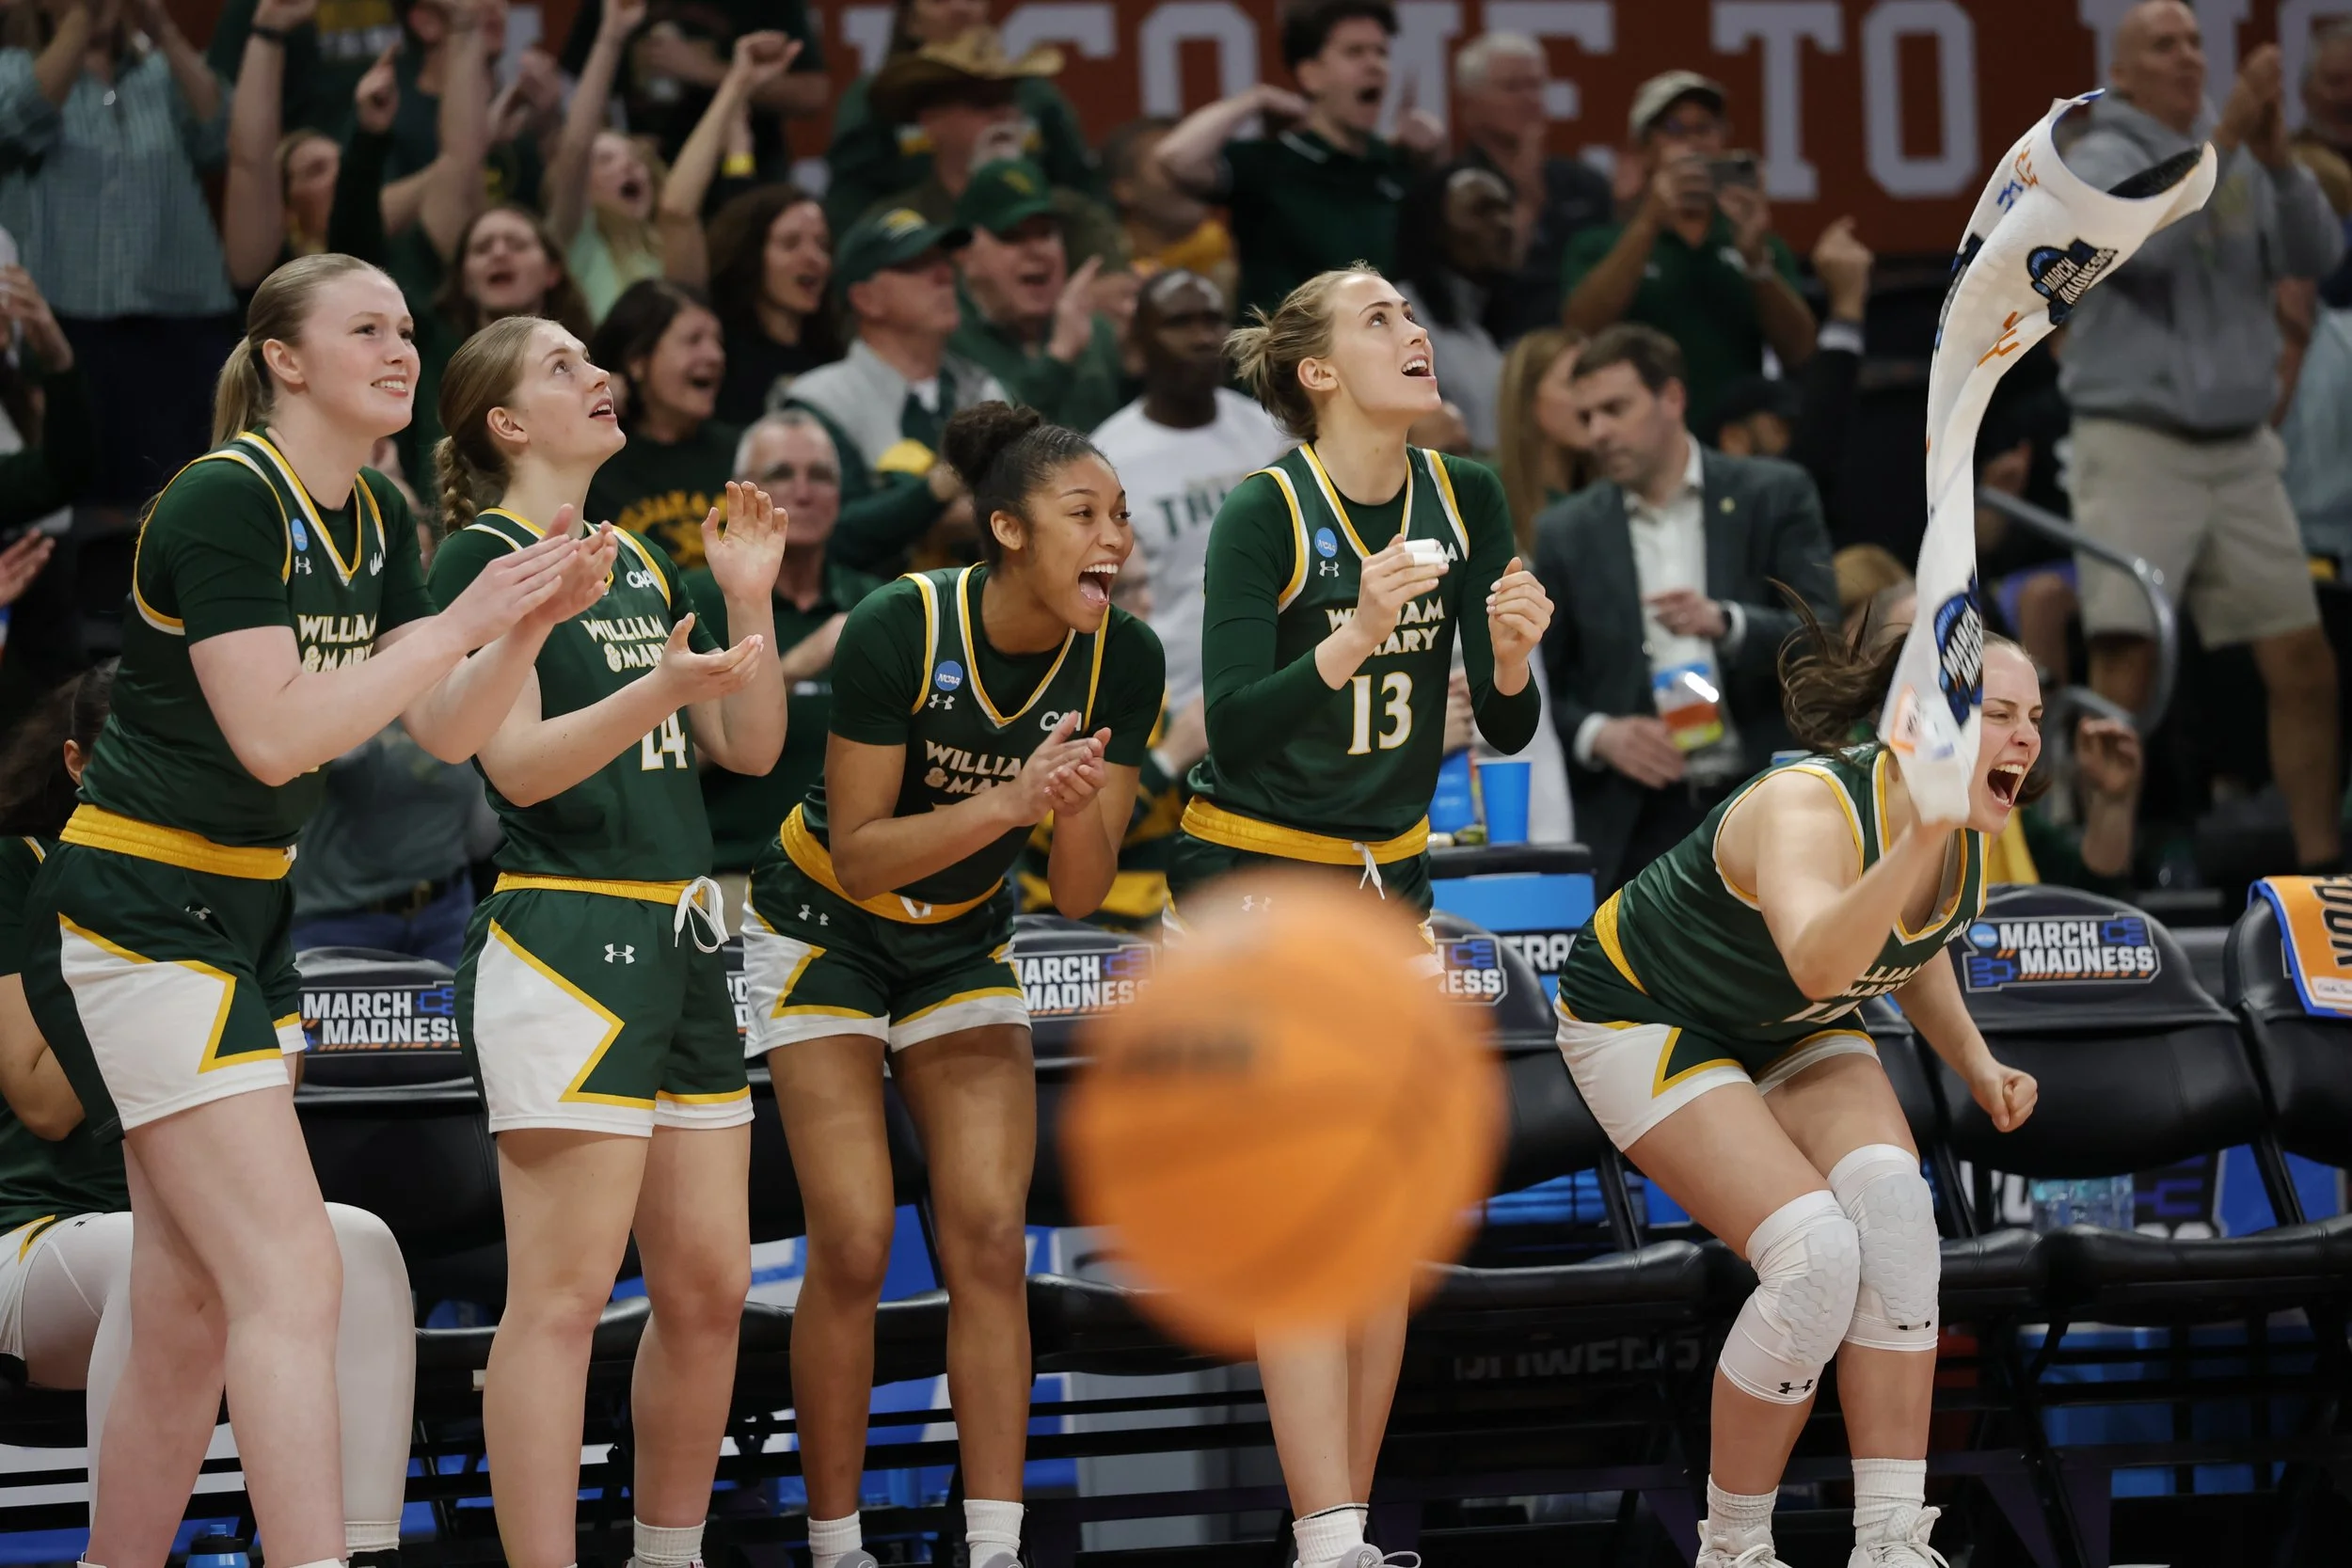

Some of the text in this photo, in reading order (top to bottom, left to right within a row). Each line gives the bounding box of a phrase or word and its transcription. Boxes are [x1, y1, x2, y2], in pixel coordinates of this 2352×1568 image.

[1712, 2, 1980, 201] TO
[2040, 256, 2080, 293] MARCH
[580, 614, 669, 643] WILLIAM
[1347, 672, 1413, 755] 13
[925, 739, 1023, 779] WILLIA
[1998, 921, 2100, 950] MARCH
[2019, 945, 2155, 974] MADNESS
[303, 991, 412, 1020] MARCH
